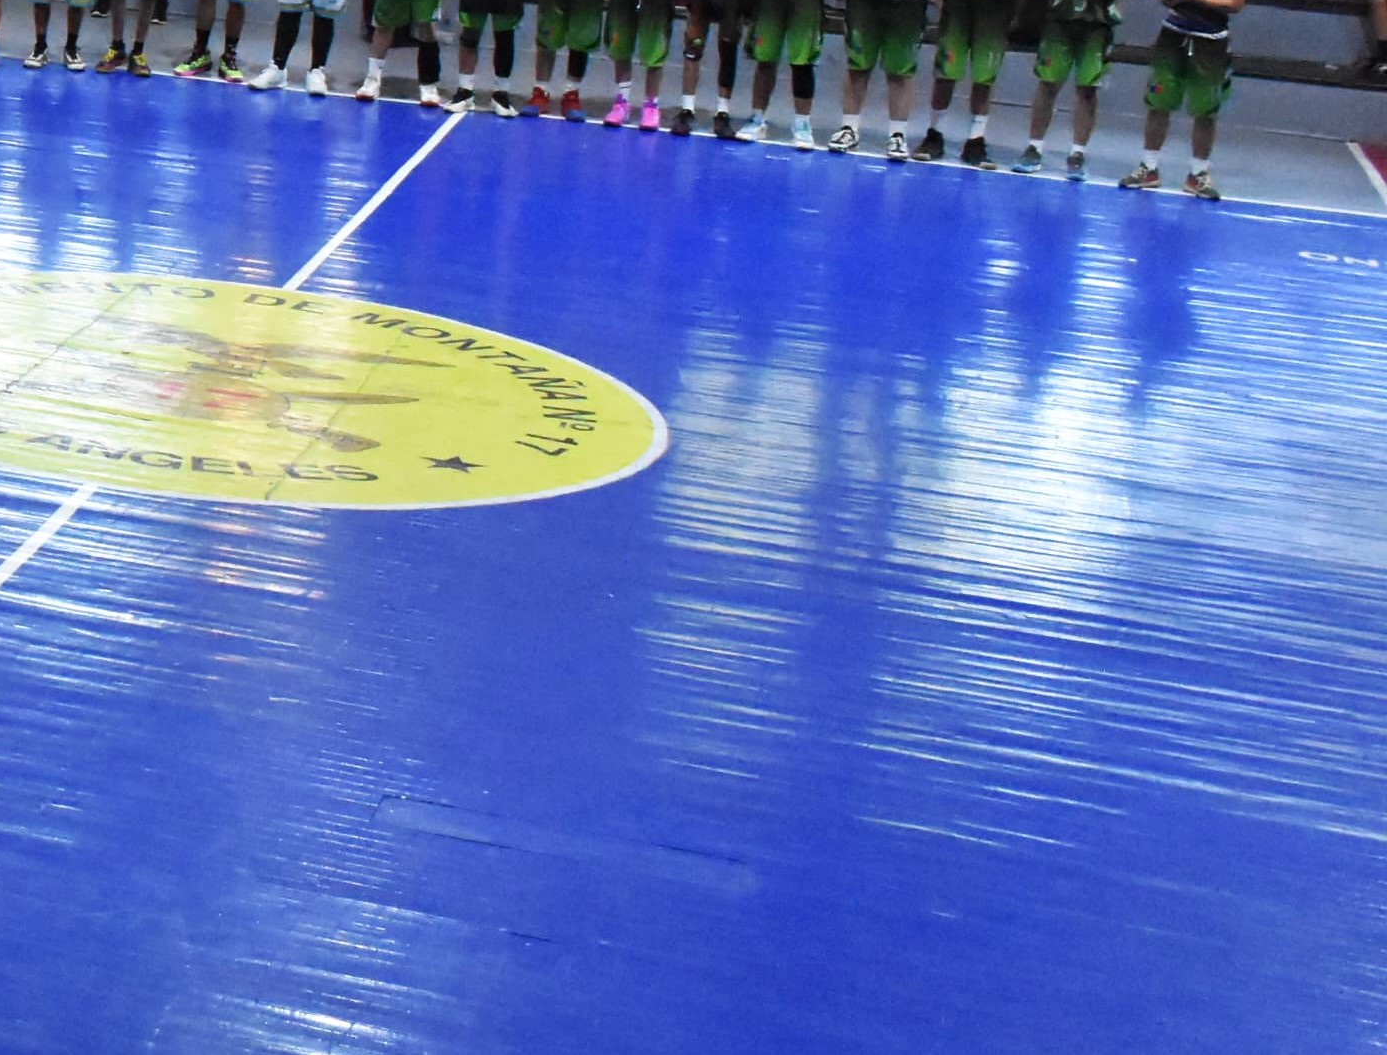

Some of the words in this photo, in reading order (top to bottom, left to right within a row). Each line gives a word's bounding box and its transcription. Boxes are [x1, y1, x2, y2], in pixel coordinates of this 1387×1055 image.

[243, 293, 335, 315] DE
[348, 311, 591, 401] MONTAÑA
[514, 432, 580, 458] 17
[24, 434, 379, 482] ANGELES
